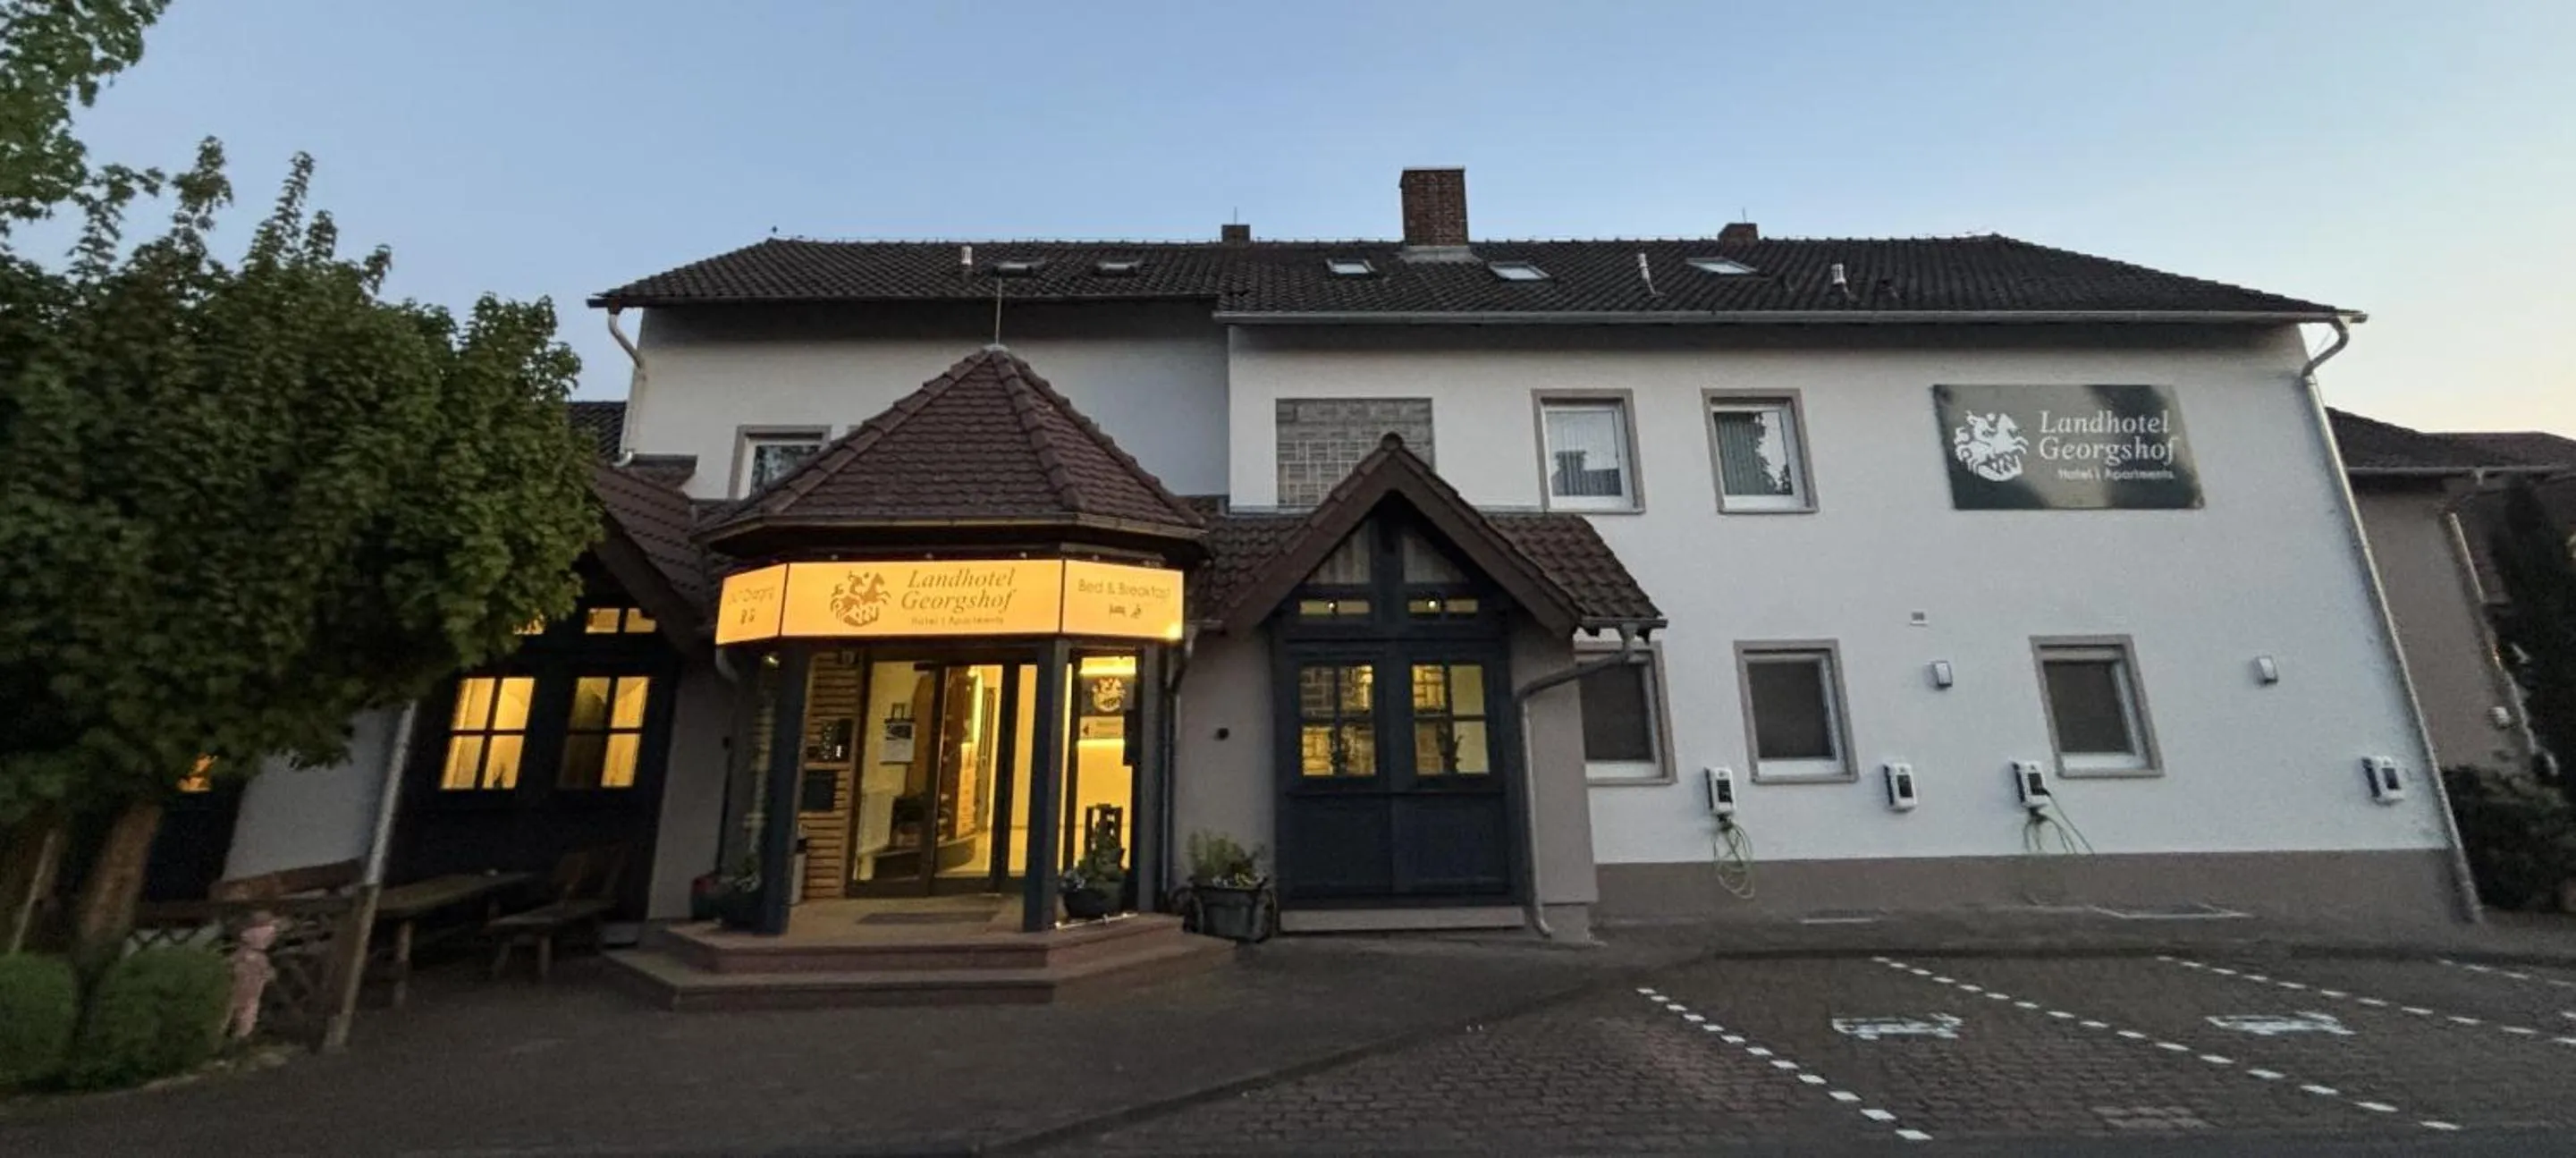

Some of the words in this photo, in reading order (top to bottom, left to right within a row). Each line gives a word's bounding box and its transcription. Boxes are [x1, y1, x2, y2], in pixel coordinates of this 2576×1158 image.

[2040, 410, 2171, 434] Landhotel
[2040, 435, 2180, 466] Georgshof
[2105, 469, 2175, 481] Apartments
[907, 566, 1016, 587] Landhotel
[1077, 578, 1103, 594] Bed
[900, 587, 1018, 614] Georgshof
